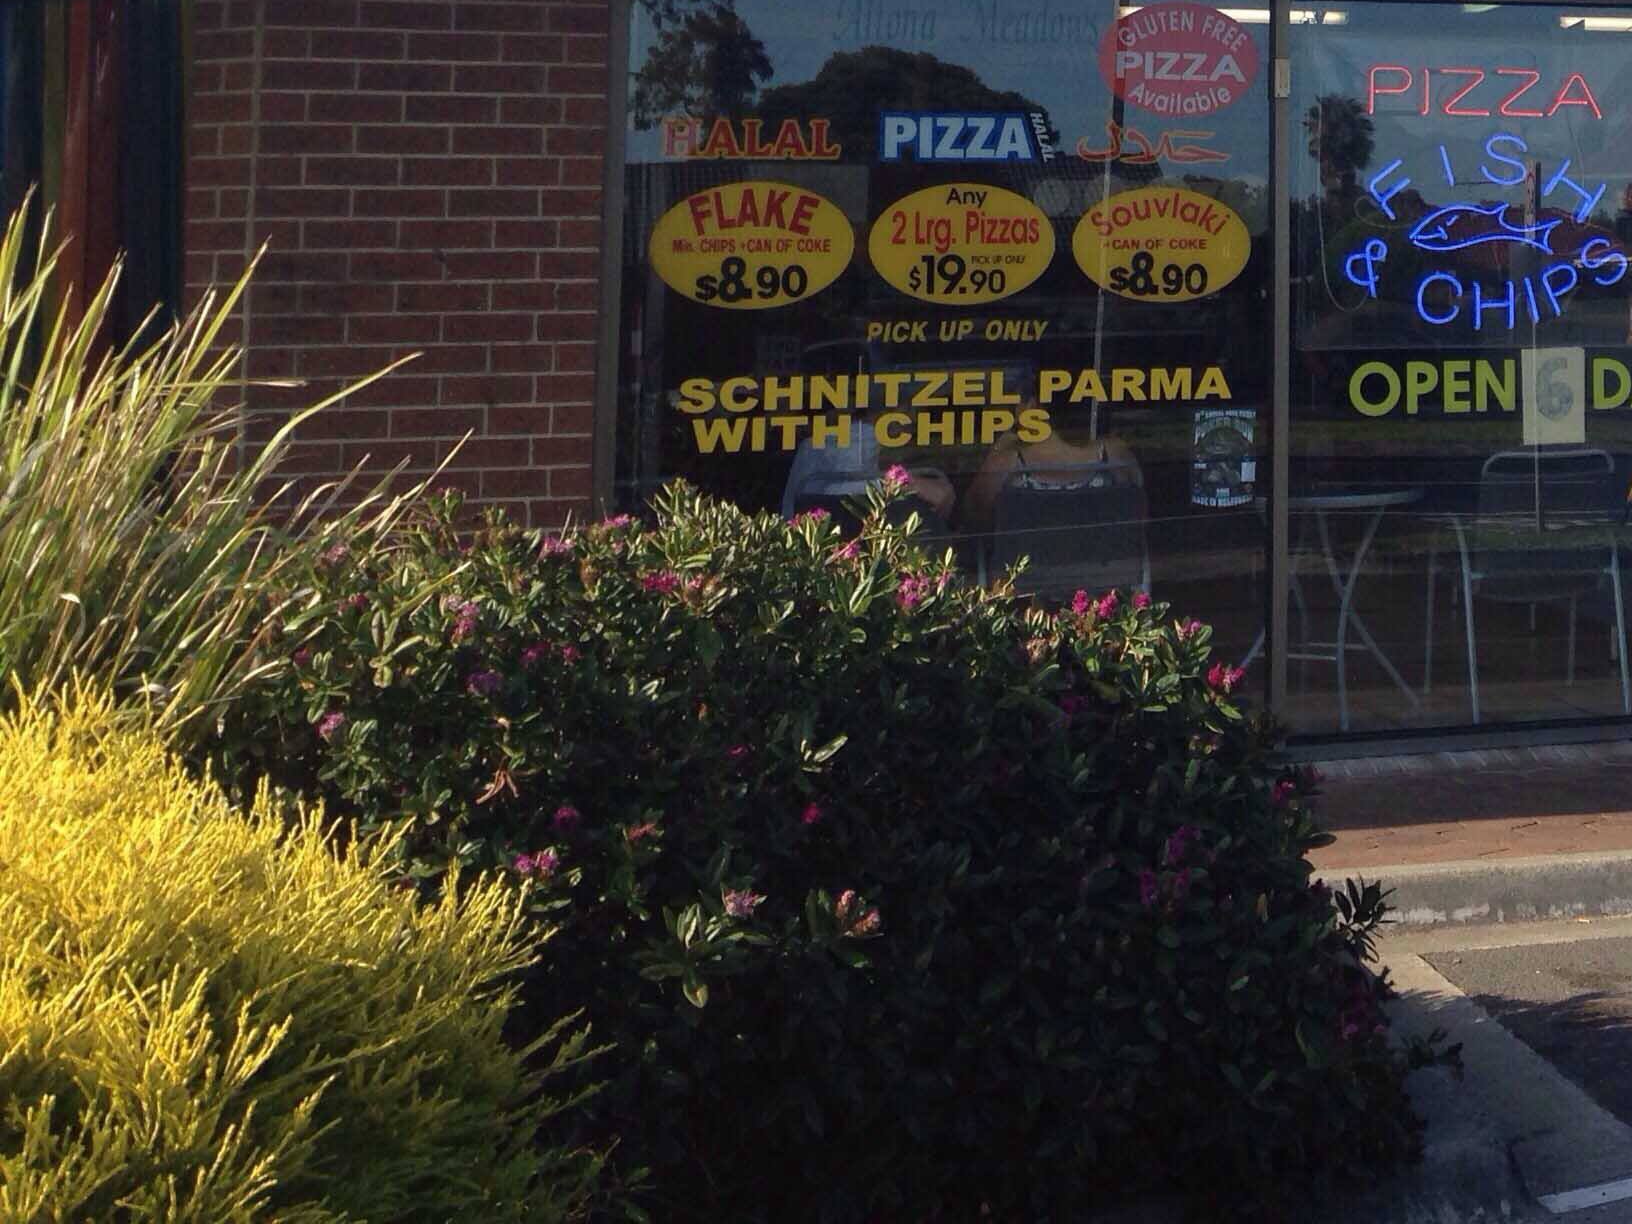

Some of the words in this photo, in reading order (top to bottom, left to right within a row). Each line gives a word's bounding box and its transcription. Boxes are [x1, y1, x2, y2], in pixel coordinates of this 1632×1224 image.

[1118, 10, 1195, 47] GLUTEN
[1202, 14, 1248, 52] FREE
[1115, 51, 1247, 83] PIZZA
[1127, 82, 1233, 114] Available
[1366, 63, 1604, 121] PIZZA
[661, 115, 842, 160] HALAL
[882, 115, 1033, 160] PIZZA
[1029, 112, 1056, 163] HALAL
[946, 187, 988, 209] Any
[1367, 131, 1607, 225] FISH
[687, 188, 821, 237] FLAKE
[891, 210, 908, 245] 2
[915, 210, 957, 254] Lrg.
[965, 210, 1040, 246] Pizzas
[1091, 192, 1231, 236] Souvlaki
[699, 239, 736, 254] CHIPS
[776, 239, 794, 253] OF
[797, 239, 832, 254] COKE
[971, 255, 990, 265] PICK
[1005, 255, 1026, 265] ONLY
[1144, 238, 1164, 251] OF
[1168, 238, 1208, 251] COKE
[695, 256, 809, 303] $8.90
[908, 253, 1007, 295] $19.90
[1109, 251, 1209, 296] $8.90
[1343, 237, 1389, 299] &
[1416, 236, 1630, 331] CHIPS
[865, 320, 929, 344] PICK
[940, 320, 974, 343] UP
[985, 319, 1049, 343] ONLY
[677, 370, 1023, 414] SCHNITZEL
[1038, 367, 1234, 406] PARMA
[1347, 358, 1517, 417] OPEN
[1533, 357, 1576, 419] 6
[691, 412, 853, 455] WITH
[873, 407, 1054, 449] CHIPS
